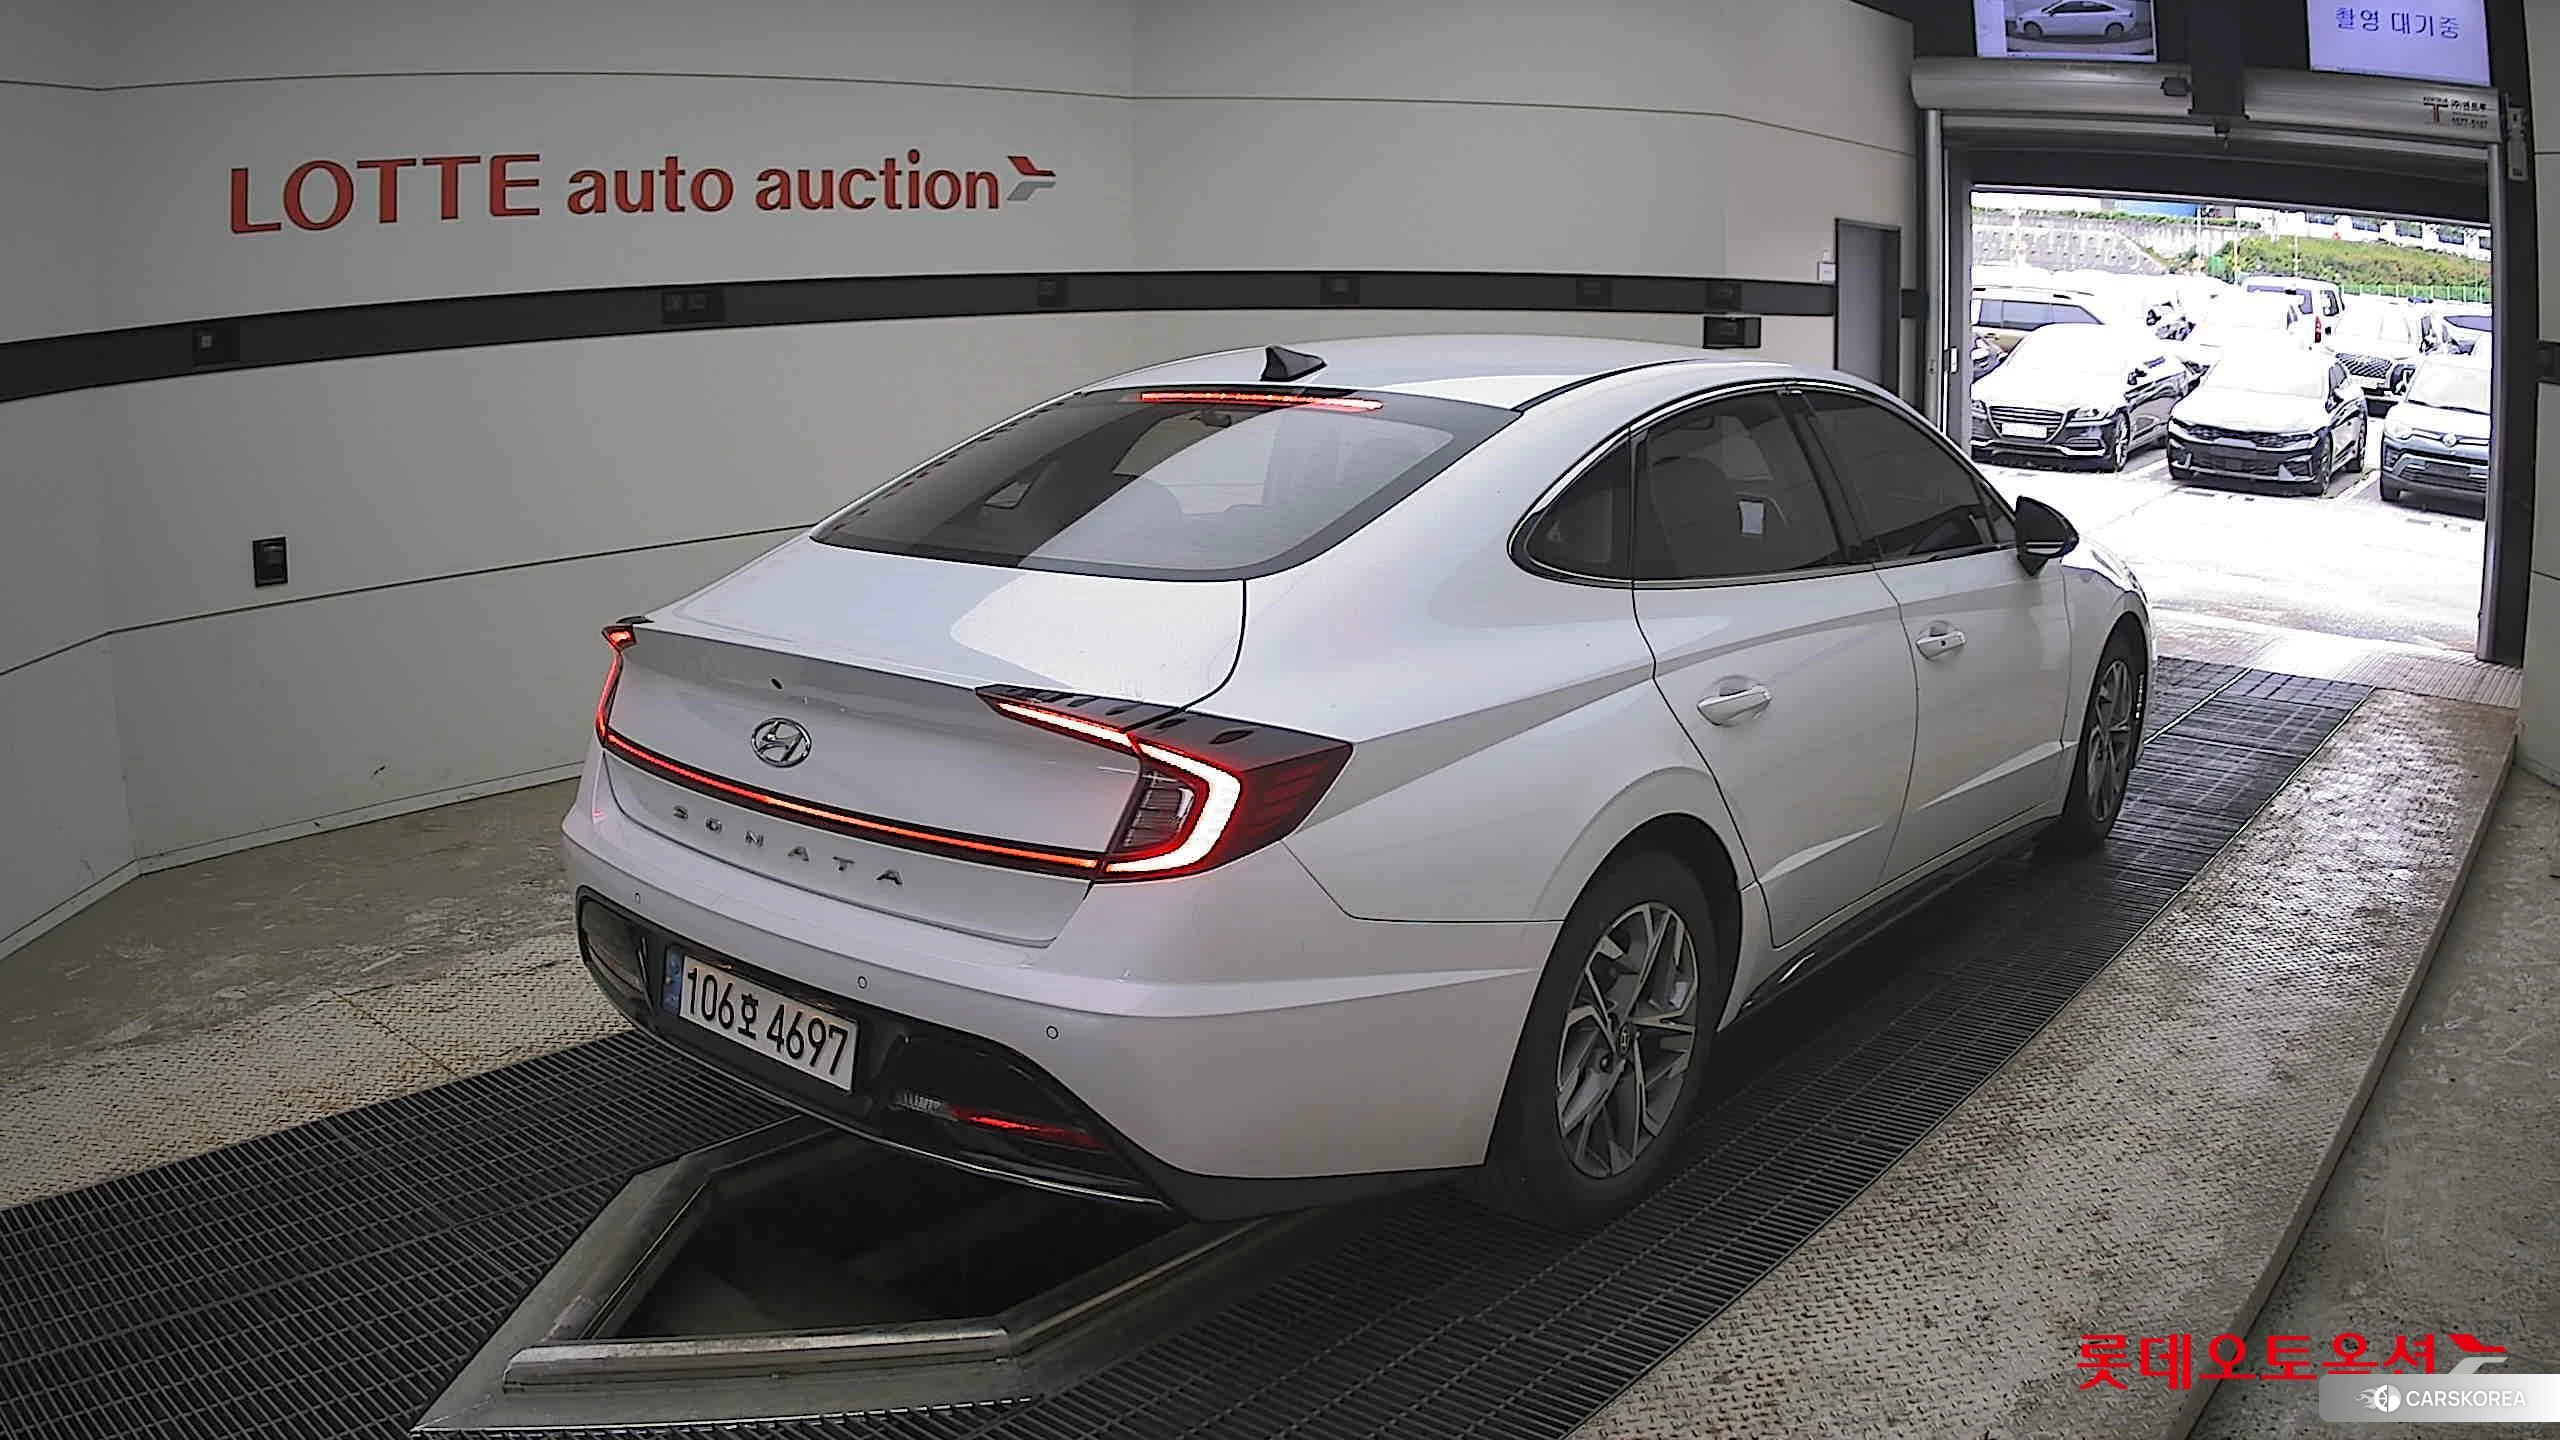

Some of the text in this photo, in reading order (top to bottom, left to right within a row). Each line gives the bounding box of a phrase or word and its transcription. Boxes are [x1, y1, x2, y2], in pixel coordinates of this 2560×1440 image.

[2391, 12, 2459, 39] 대기중
[231, 149, 1002, 234] LOTTE auto auction
[672, 805, 904, 886] SONATA
[766, 1004, 849, 1076] 4697
